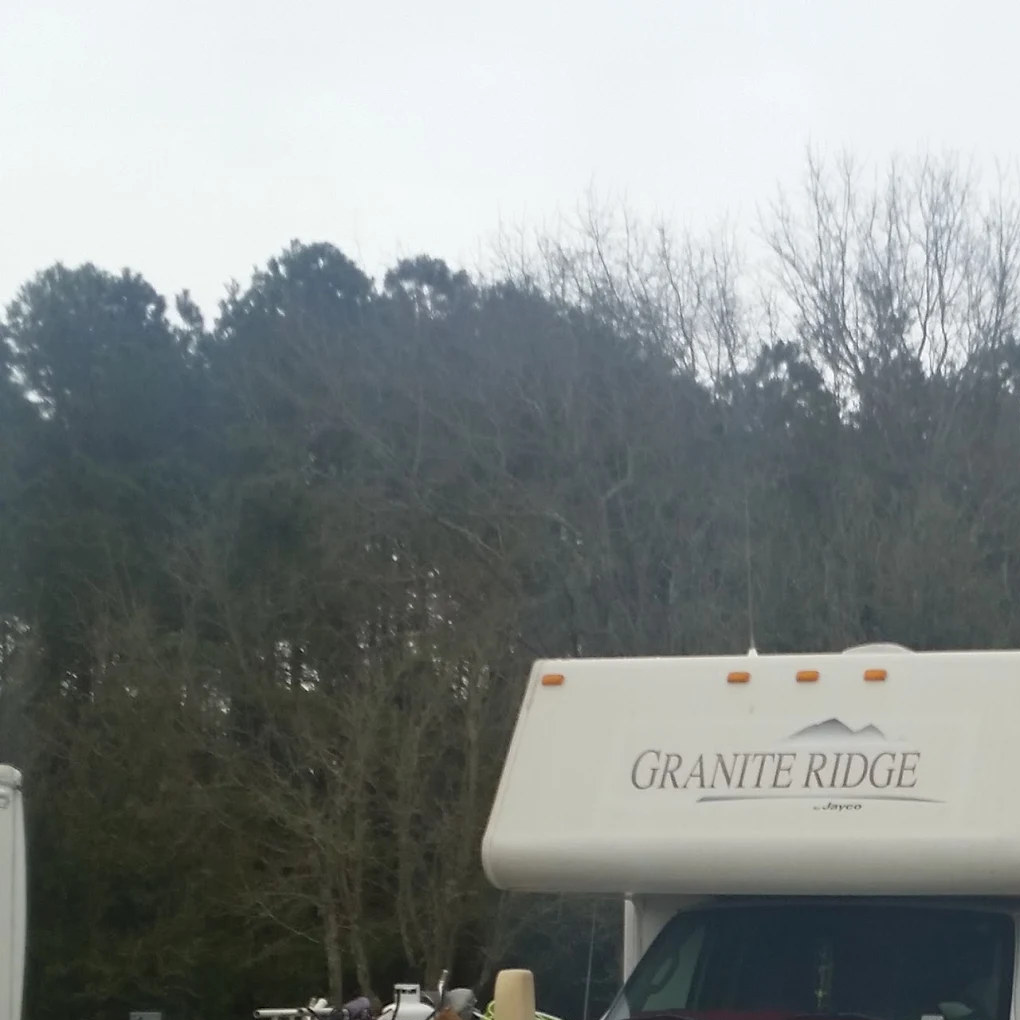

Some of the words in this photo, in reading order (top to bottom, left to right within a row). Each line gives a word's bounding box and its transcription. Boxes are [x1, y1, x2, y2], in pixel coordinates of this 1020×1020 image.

[630, 749, 797, 791] GRANITE
[803, 752, 921, 790] RIDGE
[822, 802, 862, 811] Jayco
